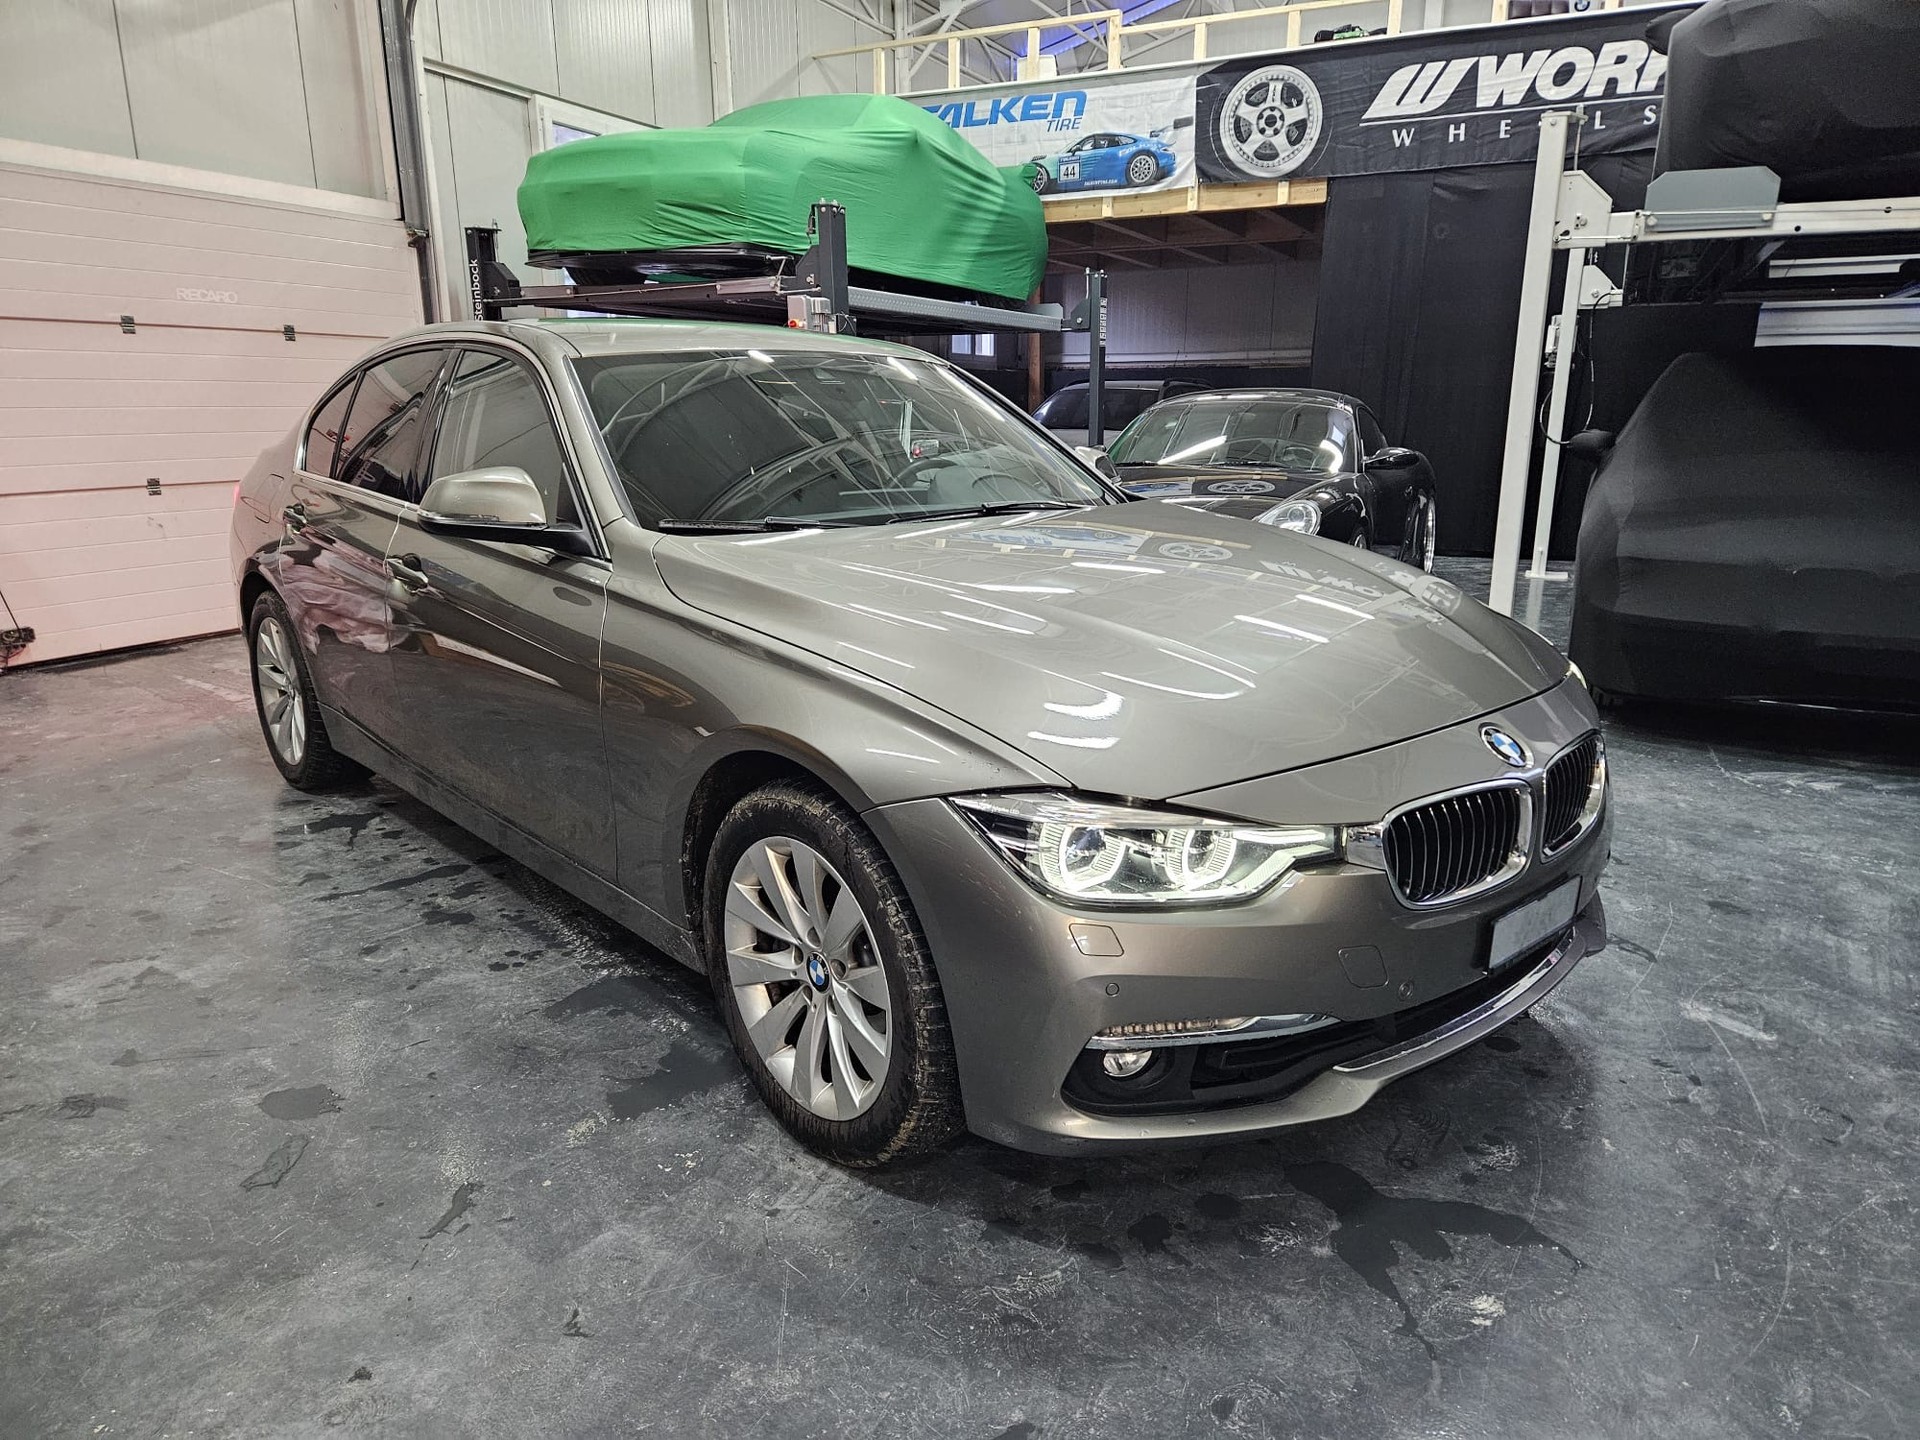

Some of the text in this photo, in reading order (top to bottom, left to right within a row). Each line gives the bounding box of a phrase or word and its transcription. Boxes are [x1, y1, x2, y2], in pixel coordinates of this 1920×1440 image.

[1046, 117, 1083, 133] TIRE
[1392, 105, 1657, 148] WHELS
[1063, 165, 1076, 179] 44
[176, 287, 238, 303] RECARO
[469, 259, 484, 321] Steinbock
